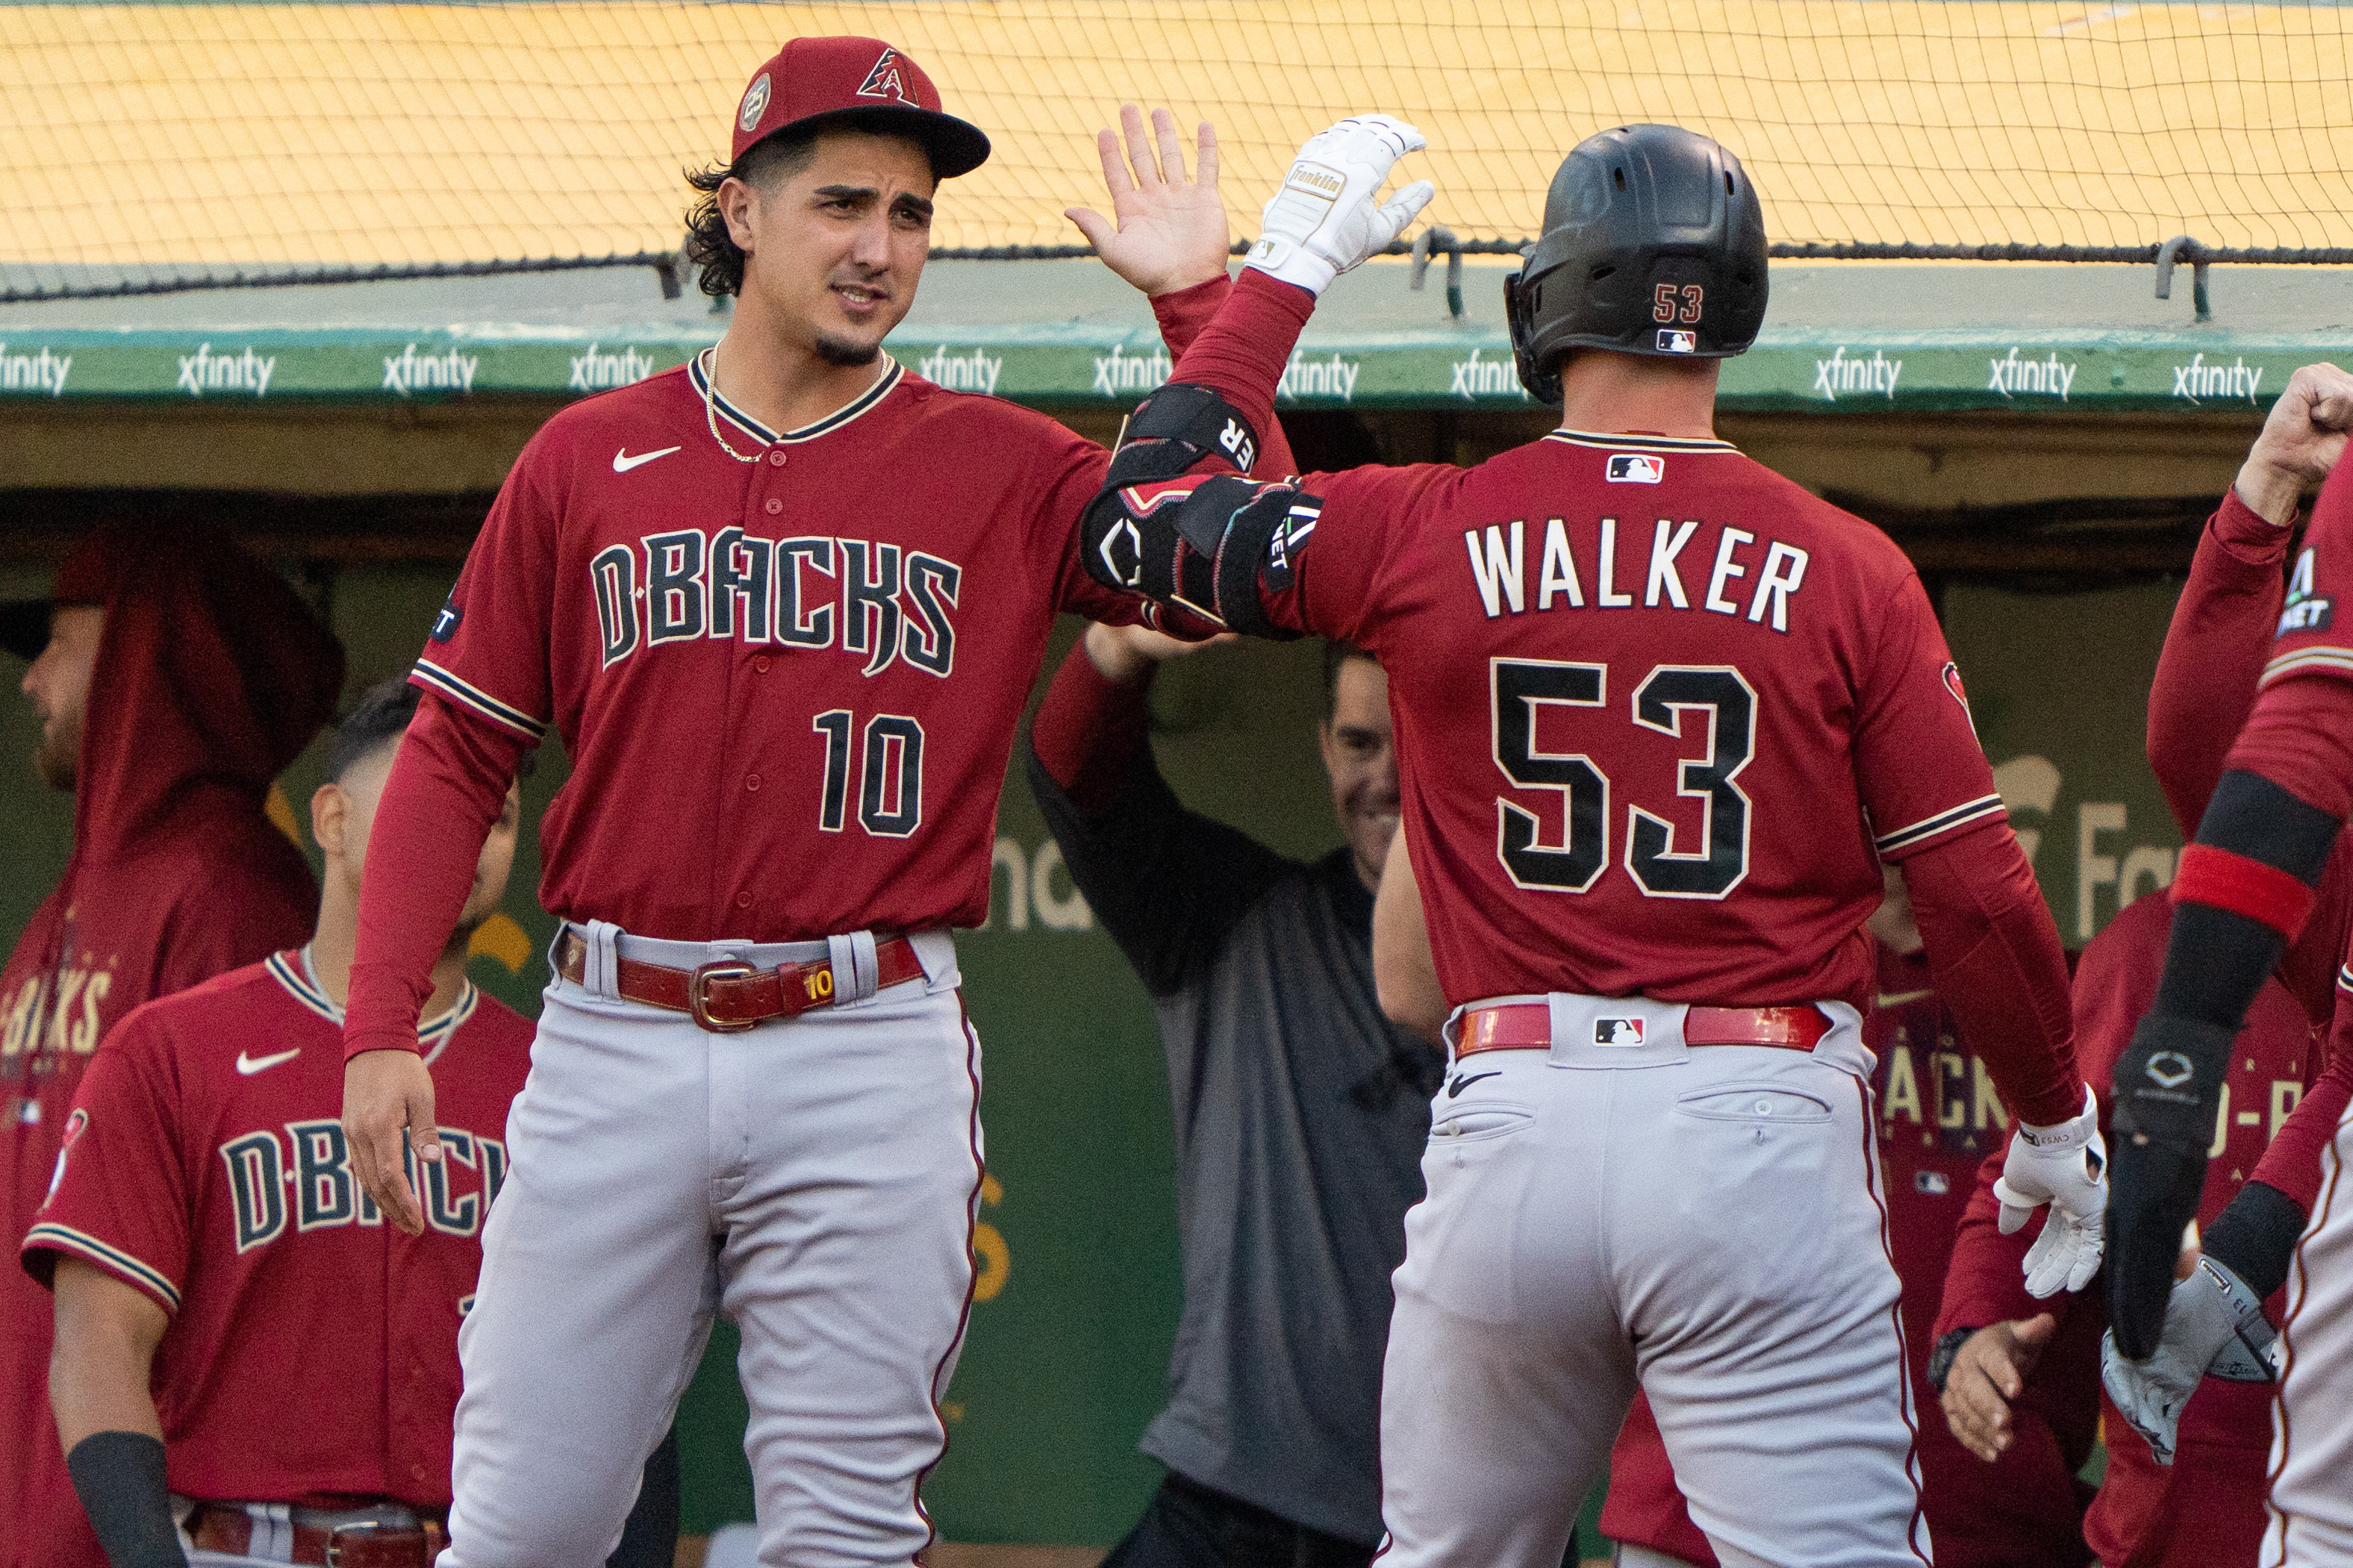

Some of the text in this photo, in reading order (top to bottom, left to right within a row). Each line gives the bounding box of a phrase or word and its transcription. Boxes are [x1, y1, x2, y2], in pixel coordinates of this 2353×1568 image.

[1653, 283, 1703, 322] 53
[177, 343, 275, 397] xfinity
[382, 343, 478, 396] xfinity
[1450, 348, 1529, 401] xfinit
[1813, 346, 1902, 402] xfinity
[1986, 346, 2077, 402] xfinity
[2172, 352, 2263, 405] xfinity
[1465, 519, 1809, 633] WALKER
[812, 708, 925, 839] 10
[1490, 657, 1758, 900] 53
[803, 970, 832, 1000] 10
